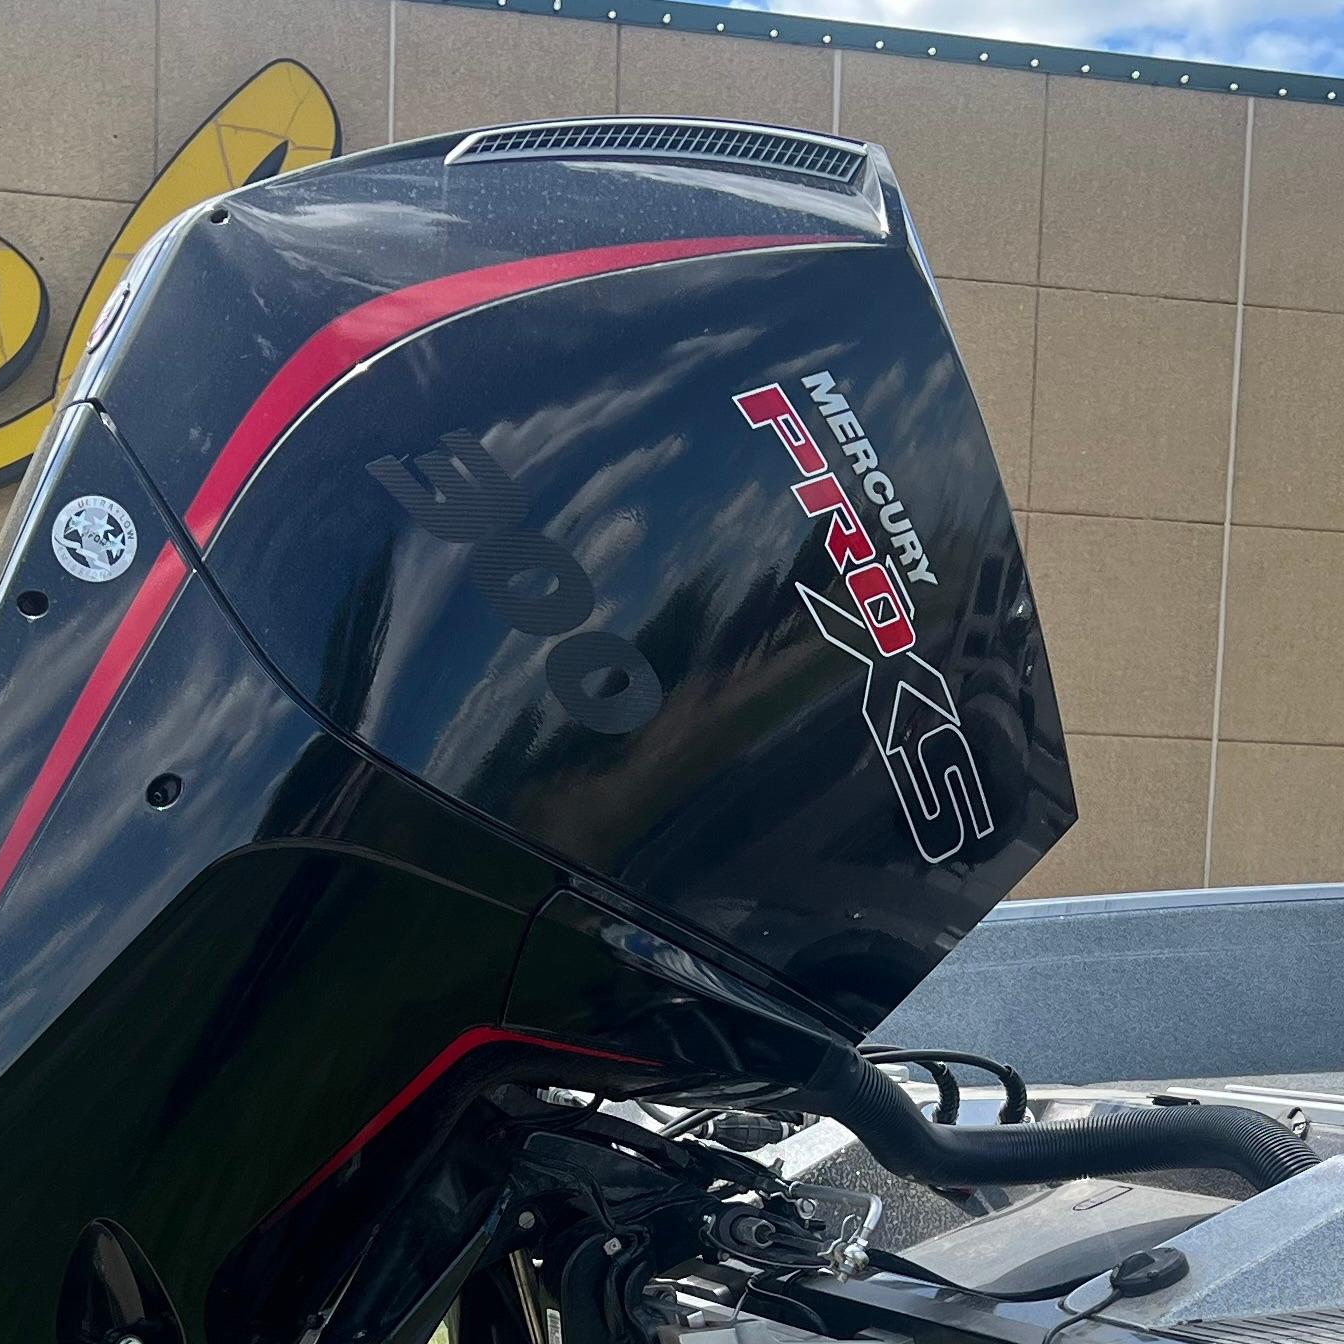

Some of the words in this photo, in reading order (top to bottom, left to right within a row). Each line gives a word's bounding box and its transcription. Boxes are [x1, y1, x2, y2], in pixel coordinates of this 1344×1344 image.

[731, 382, 916, 657] PRO
[800, 370, 938, 588] MERCURY
[794, 554, 994, 864] XS
